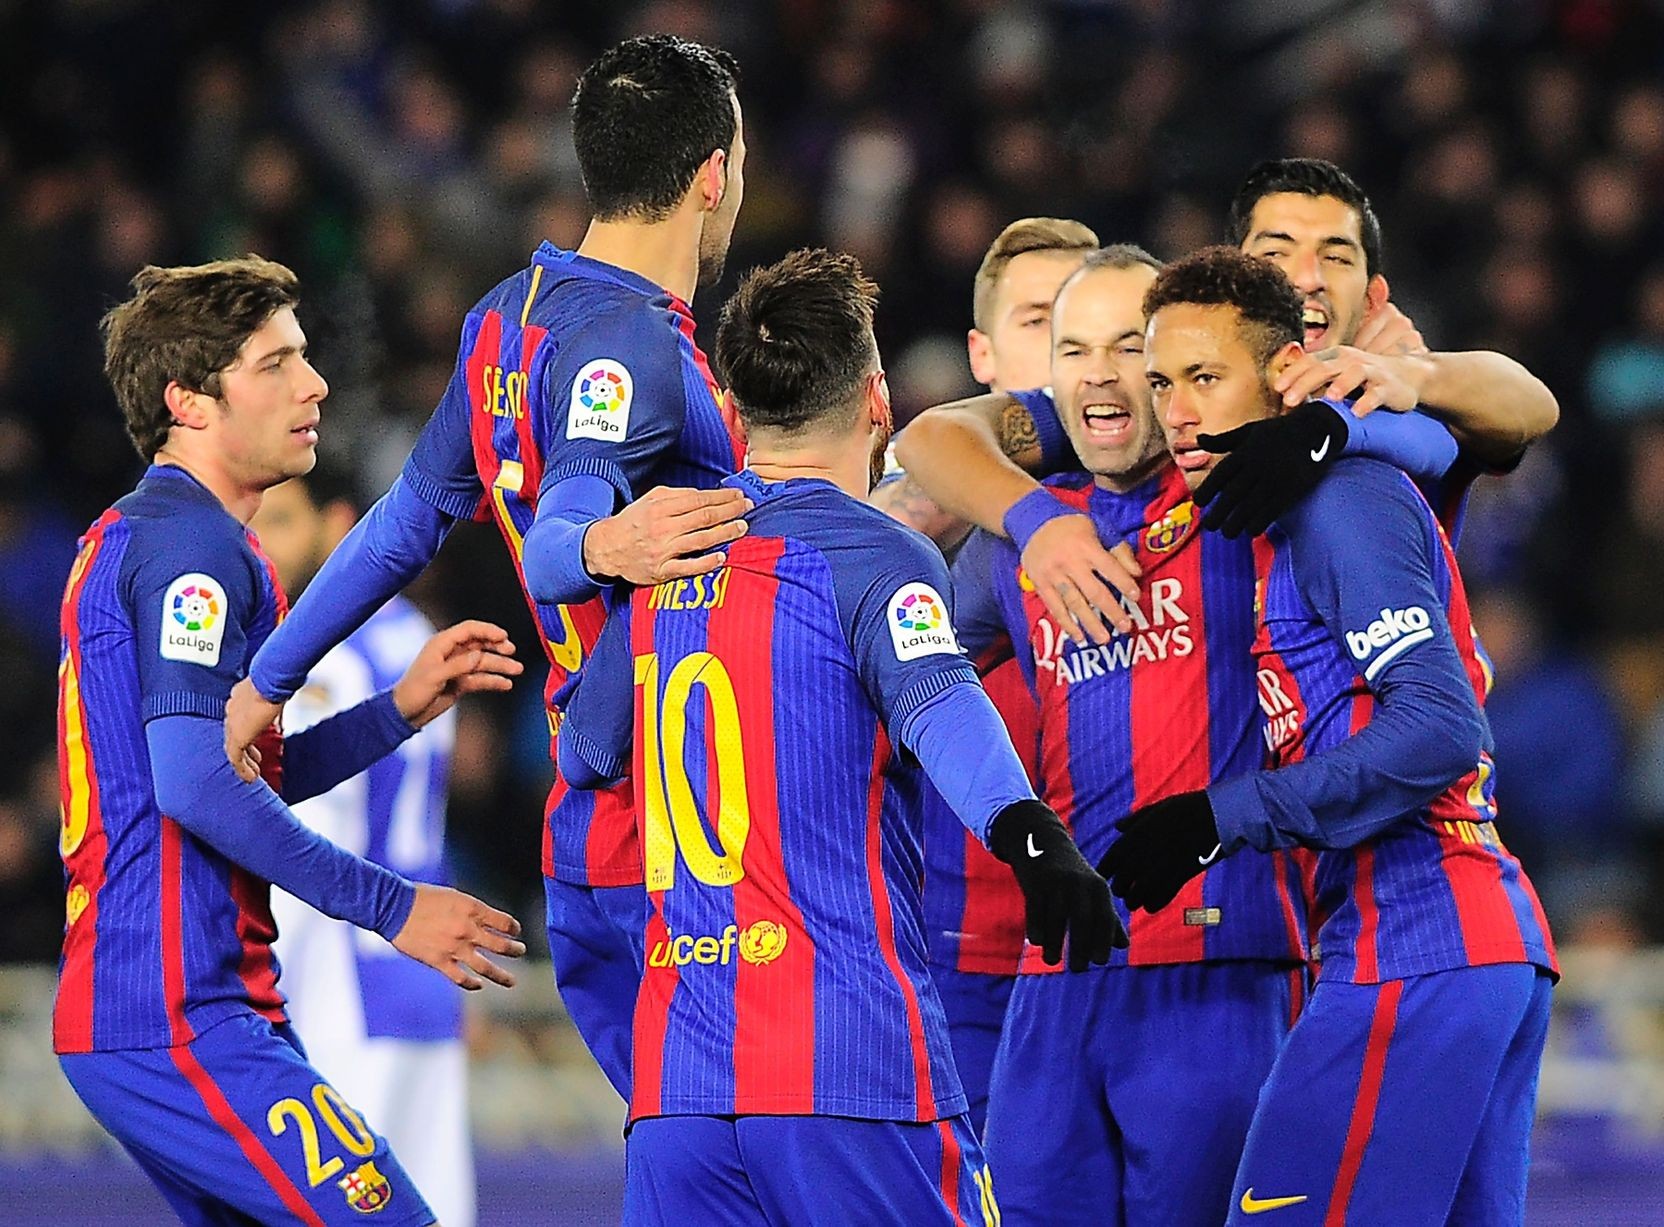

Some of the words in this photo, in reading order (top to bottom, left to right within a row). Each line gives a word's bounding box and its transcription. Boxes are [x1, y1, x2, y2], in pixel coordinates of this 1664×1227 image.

[575, 414, 619, 432] LaLiga
[647, 566, 732, 611] MESSI
[168, 634, 215, 652] LaLiga
[901, 633, 951, 650] LaLiga
[1056, 624, 1194, 687] AIRWAYS
[1345, 606, 1430, 660] beko
[633, 651, 751, 893] 10
[267, 1084, 376, 1188] 20
